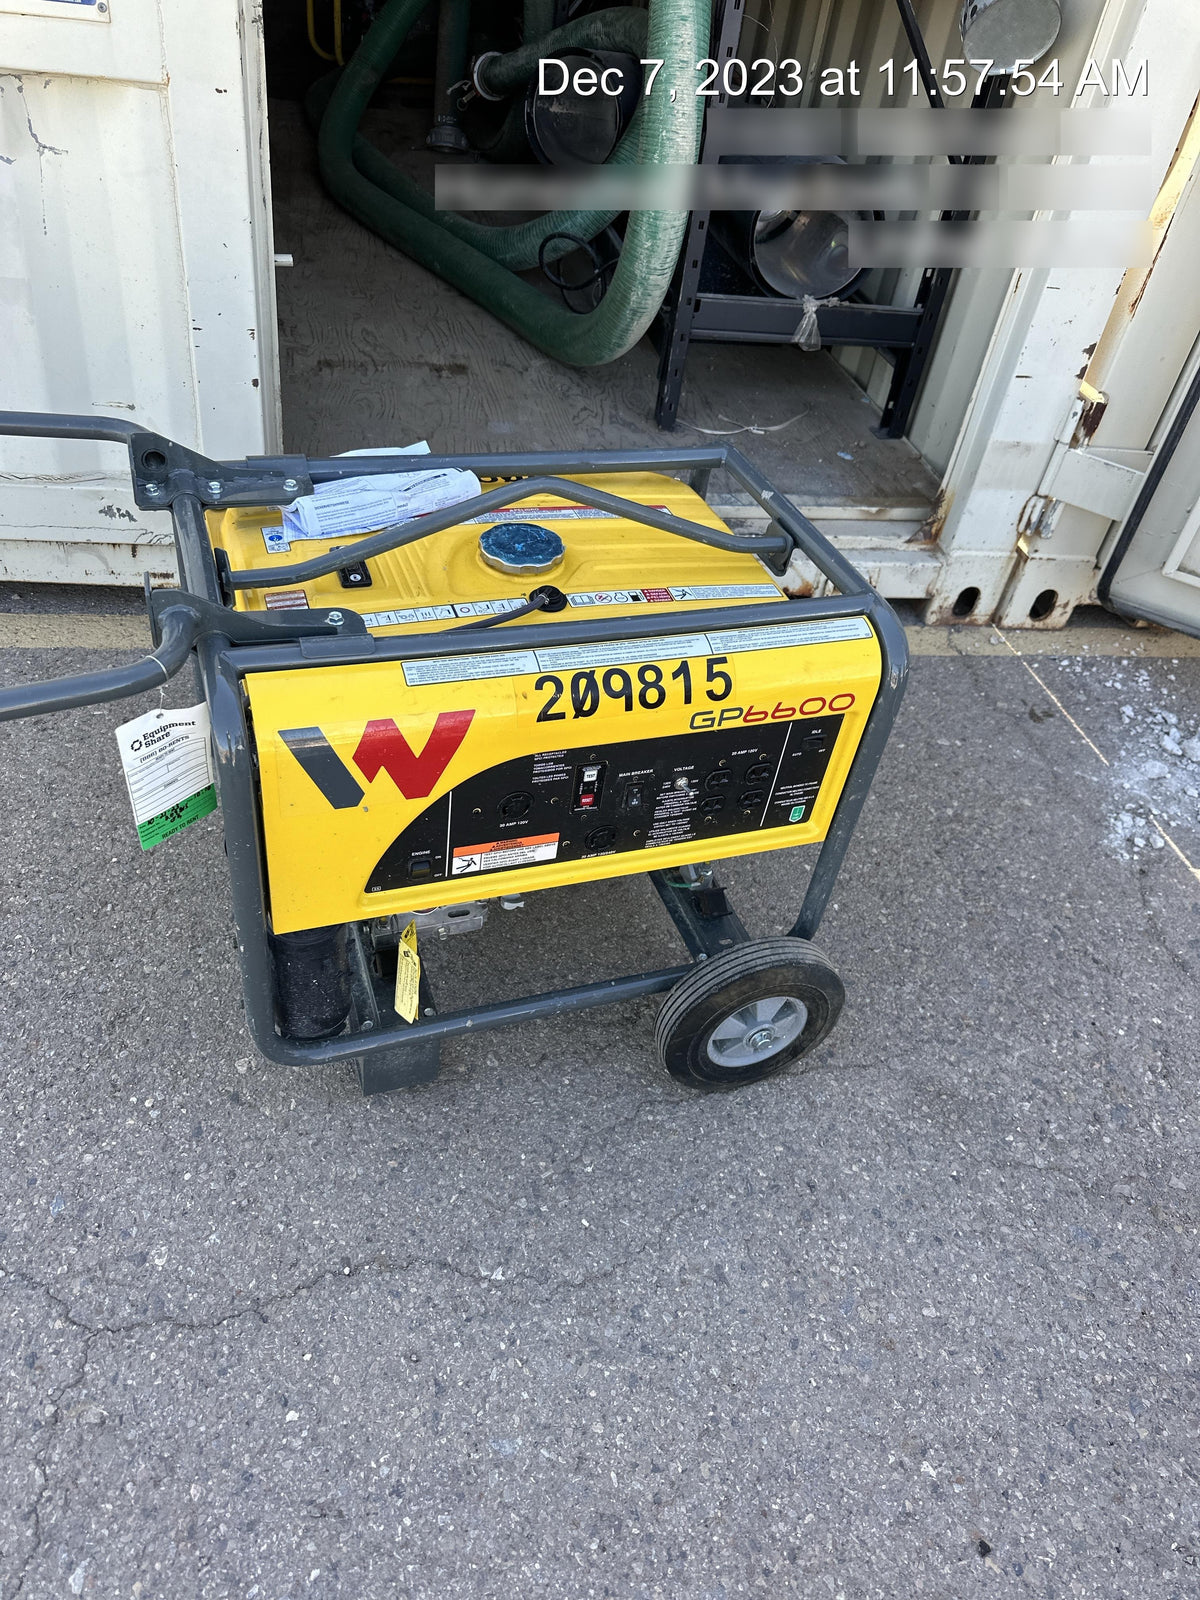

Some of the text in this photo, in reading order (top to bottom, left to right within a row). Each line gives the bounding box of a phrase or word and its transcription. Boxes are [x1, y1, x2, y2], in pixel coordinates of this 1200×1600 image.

[689, 693, 856, 730] GP6600
[142, 720, 197, 741] Equipment
[144, 731, 171, 748] Share
[411, 849, 431, 857] ENGINE
